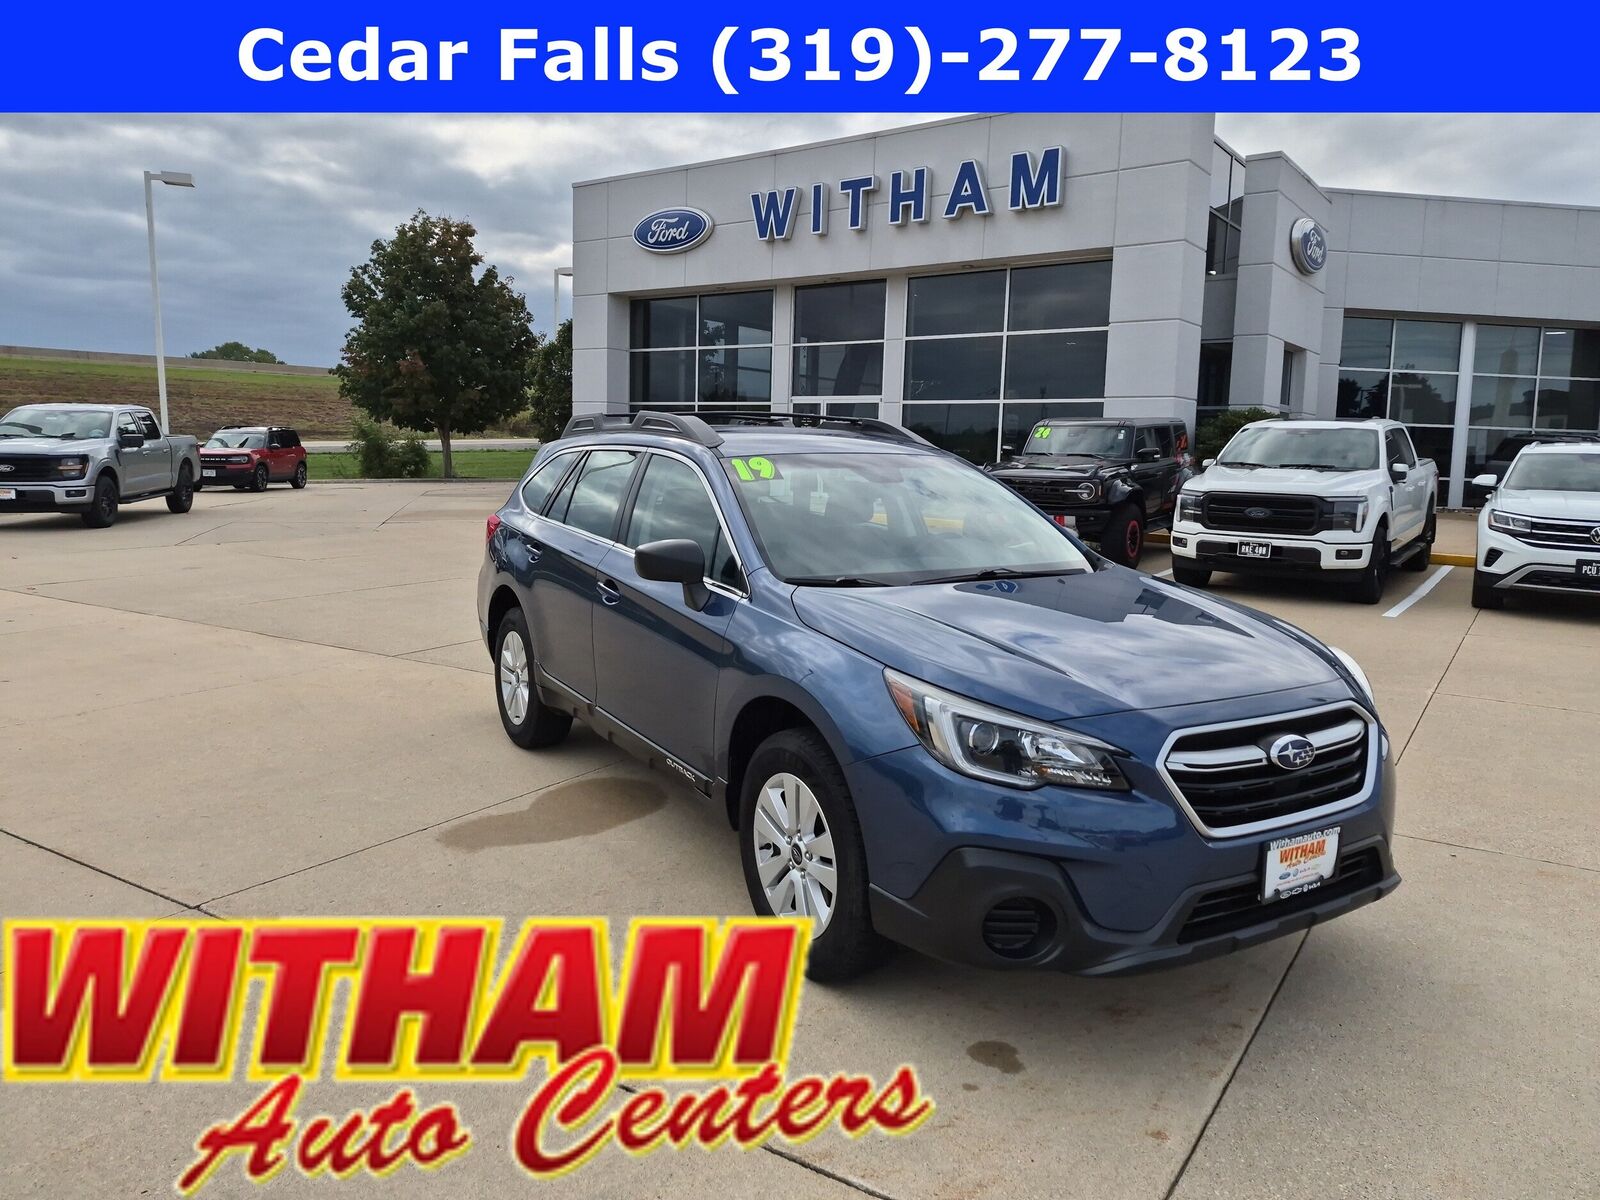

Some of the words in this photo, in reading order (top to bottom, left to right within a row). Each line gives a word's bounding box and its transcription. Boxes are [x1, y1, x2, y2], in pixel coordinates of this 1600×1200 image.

[750, 145, 1064, 241] WITHAM
[648, 217, 689, 243] Ford
[1307, 230, 1324, 263] Ford
[731, 456, 775, 481] 19
[1280, 839, 1327, 864] WITHAM
